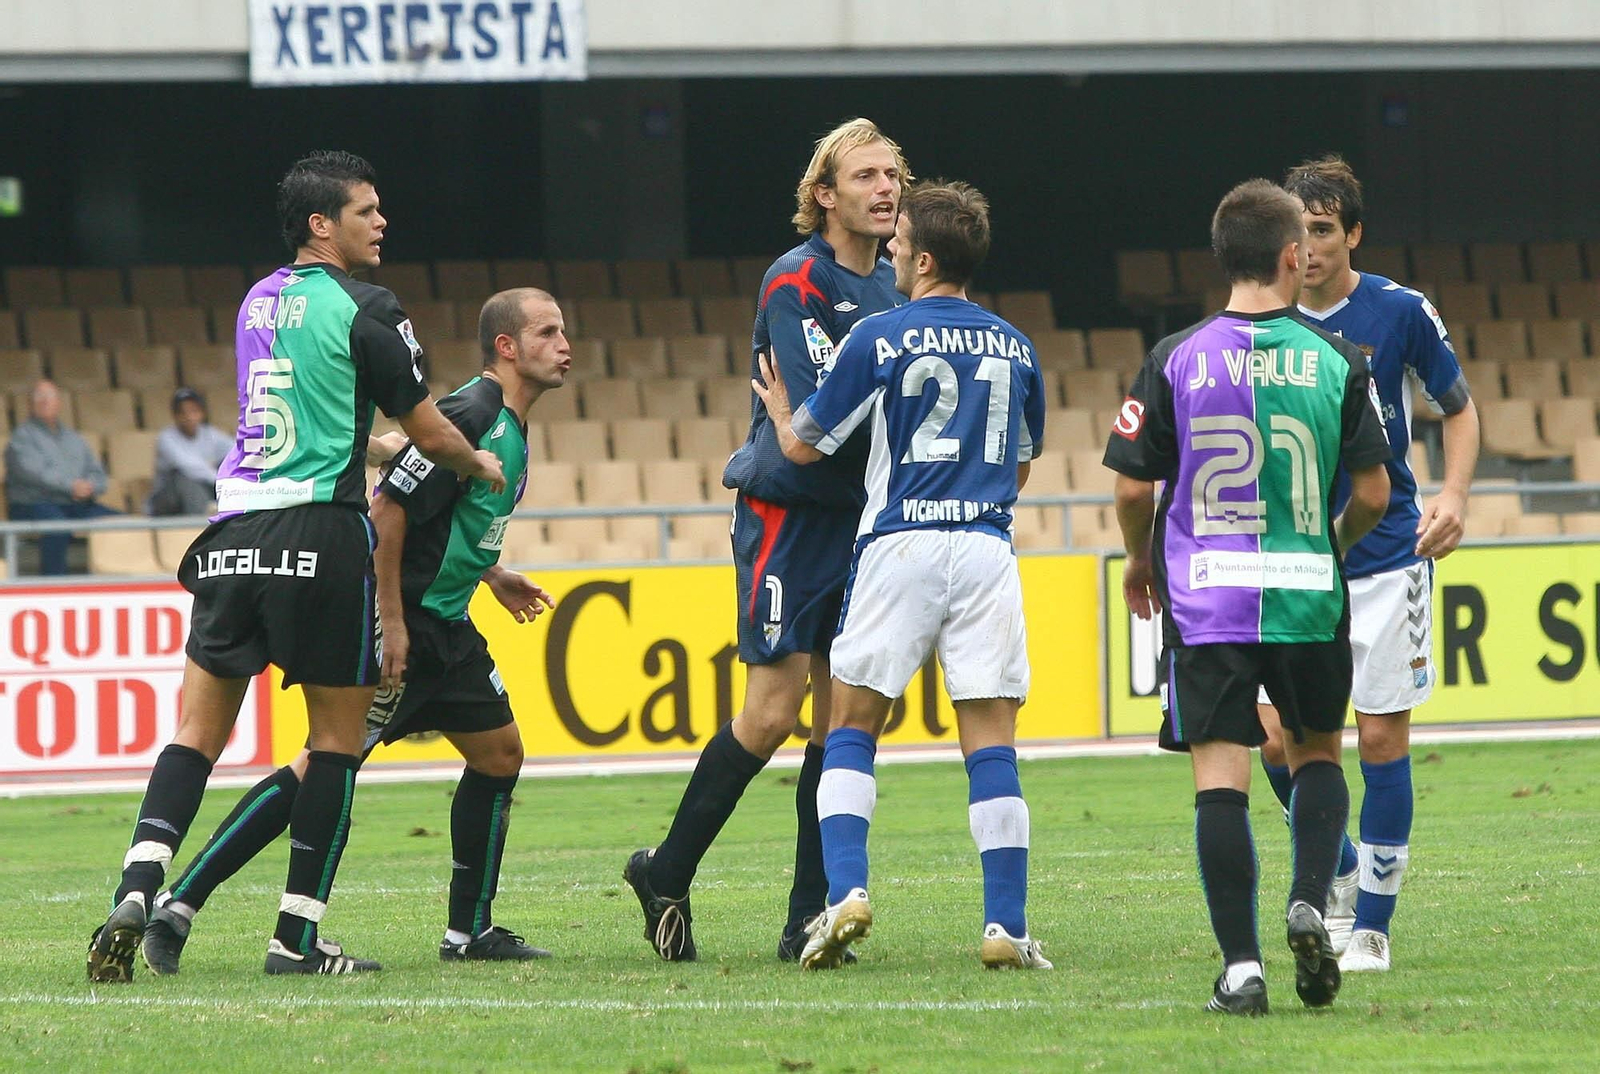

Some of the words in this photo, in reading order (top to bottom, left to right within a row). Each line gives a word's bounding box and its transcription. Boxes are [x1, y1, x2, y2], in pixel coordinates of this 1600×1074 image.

[273, 2, 567, 66] XERECISTA
[244, 295, 307, 330] SILVA
[1190, 352, 1216, 390] J.
[1222, 349, 1319, 388] VALLE
[238, 358, 296, 469] 5
[901, 355, 1011, 466] 21
[404, 454, 427, 473] LFP
[1190, 415, 1322, 536] 21
[903, 499, 961, 522] VICENTE
[1280, 564, 1291, 574] de
[764, 574, 783, 622] 1
